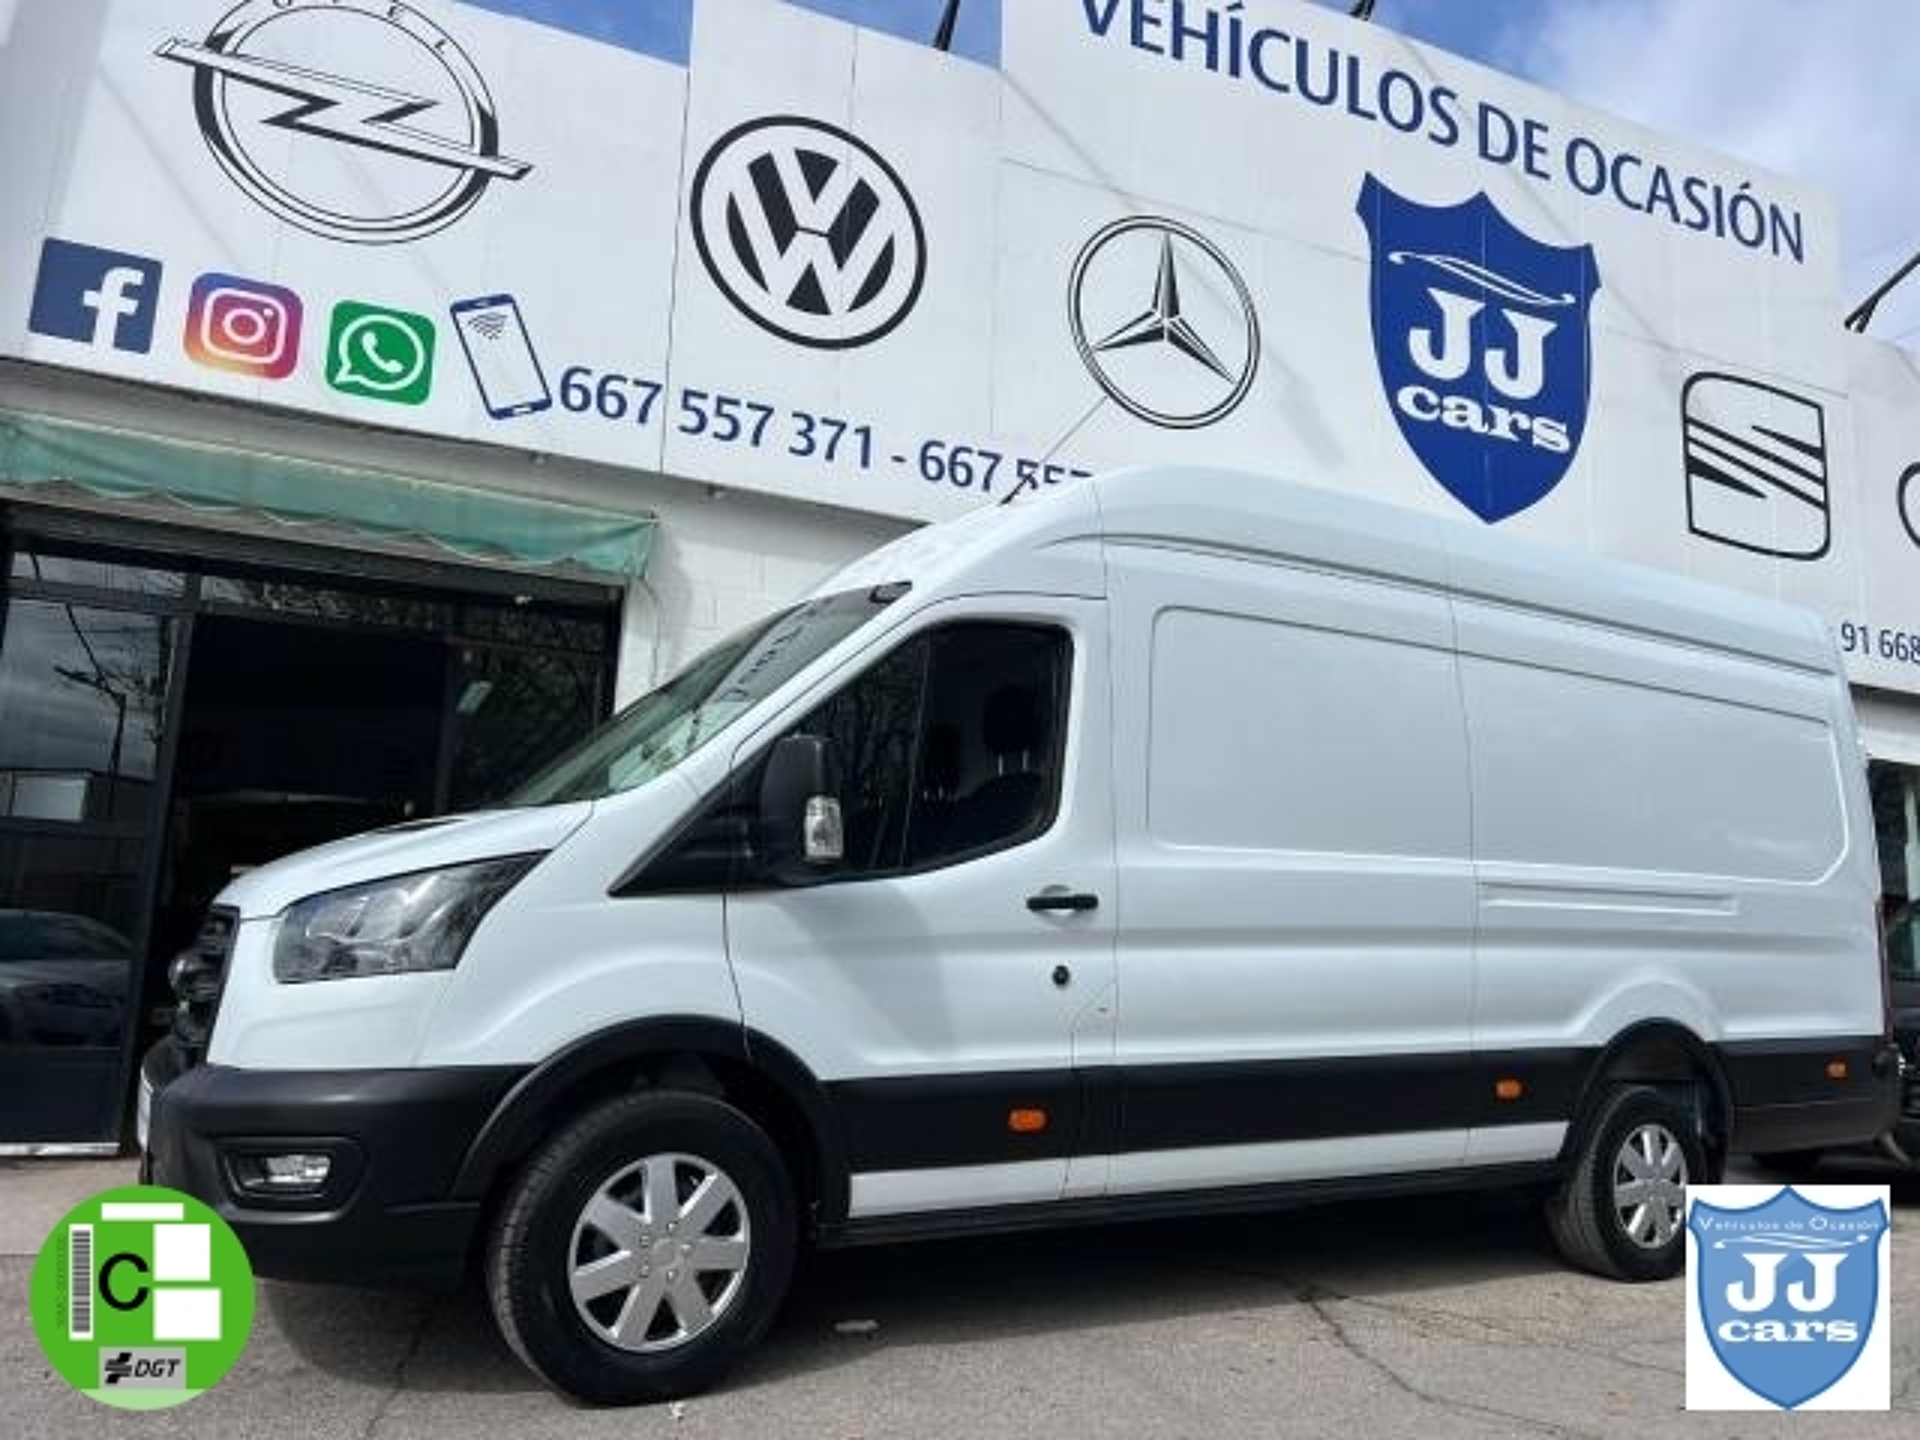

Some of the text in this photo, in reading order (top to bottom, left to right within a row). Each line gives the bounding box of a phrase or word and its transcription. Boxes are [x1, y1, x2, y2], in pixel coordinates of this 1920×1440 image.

[1083, 0, 1803, 264] VEHÍCULOS DE OCASIÓN
[1408, 287, 1558, 399] JJ
[559, 366, 663, 425] 667
[679, 389, 774, 447] 557
[789, 410, 871, 468] 371
[919, 440, 1003, 493] 667
[1016, 458, 1094, 491] 55
[1397, 386, 1571, 453] cars
[1841, 622, 1920, 667] 91 668
